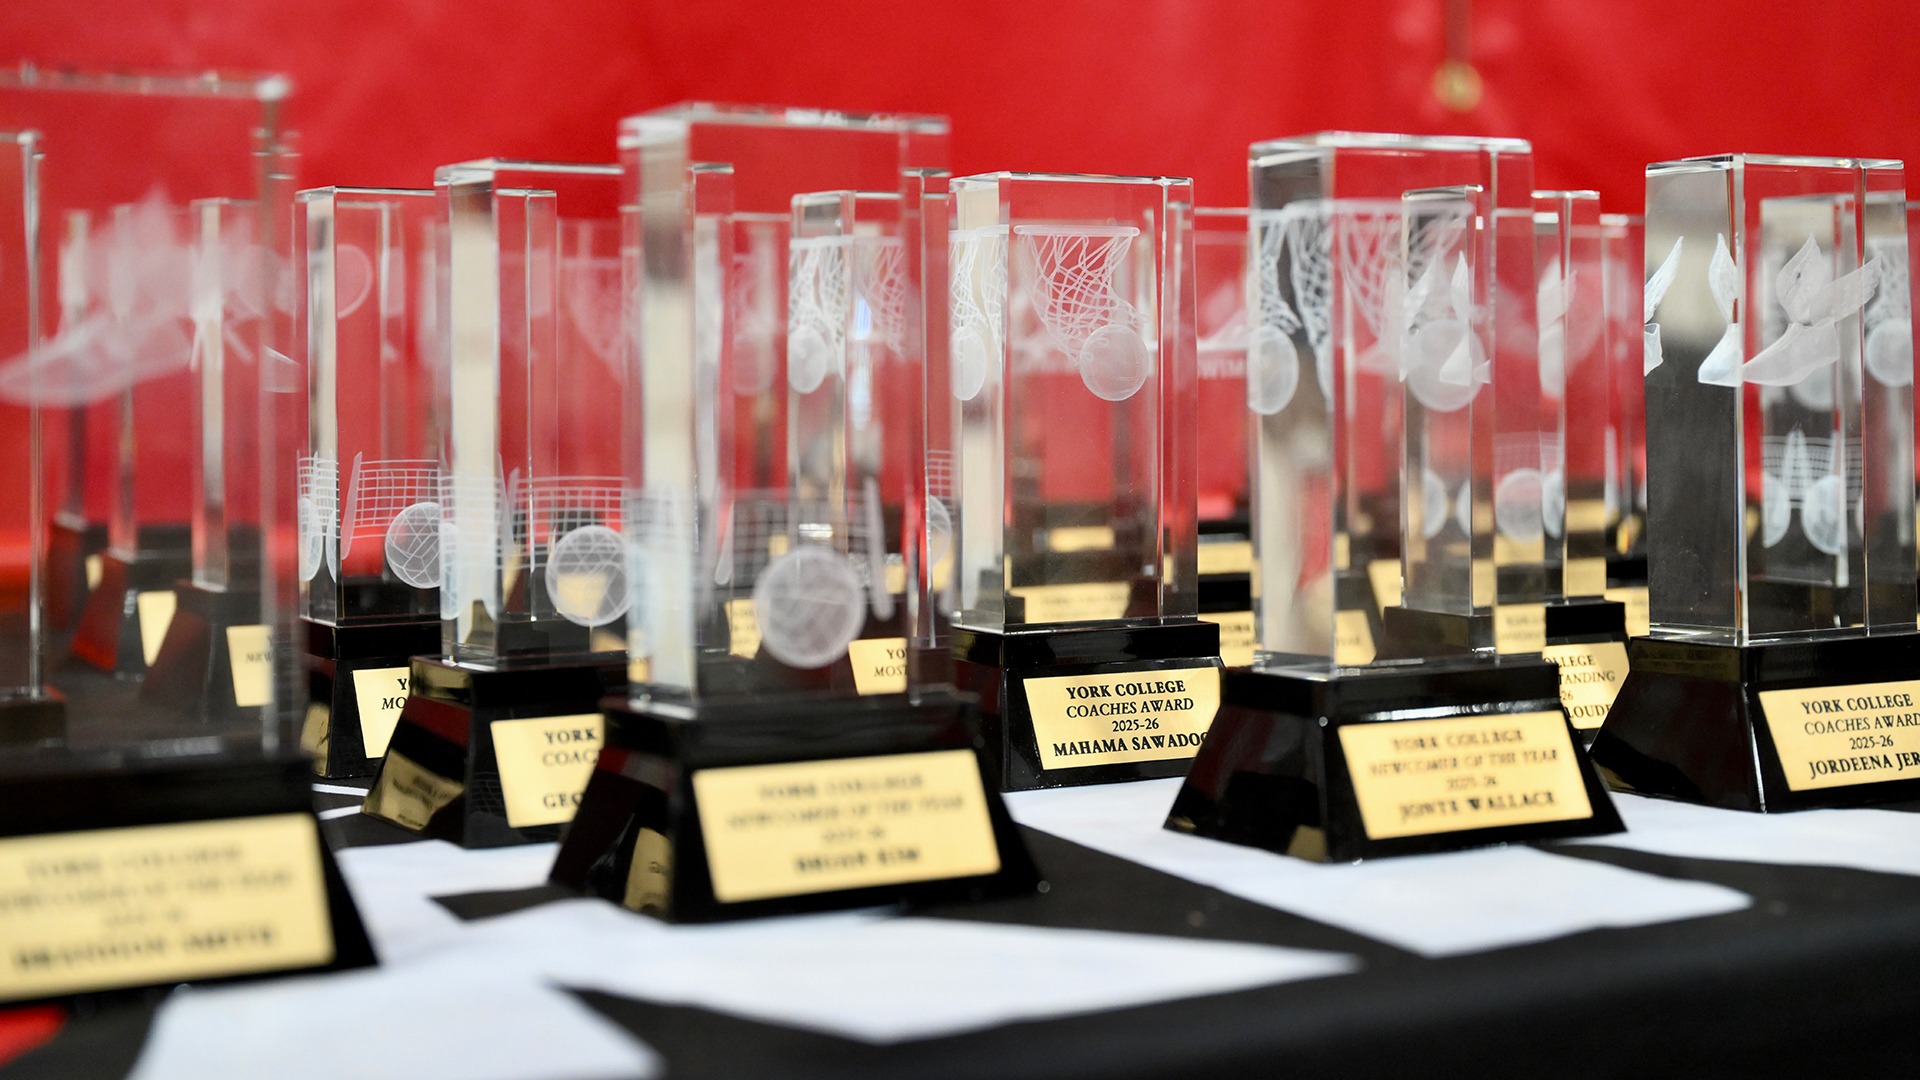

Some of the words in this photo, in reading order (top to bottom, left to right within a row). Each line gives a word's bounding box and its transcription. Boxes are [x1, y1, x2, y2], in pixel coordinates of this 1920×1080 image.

[1066, 685, 1112, 700] YORK
[1115, 680, 1186, 697] COLLEGE
[1066, 701, 1137, 719] COACHES
[1141, 697, 1194, 713] AWARD
[1801, 699, 1844, 715] YORK
[1846, 693, 1914, 712] COLLEGE
[1112, 717, 1160, 732] 2025-26
[1804, 716, 1871, 736] COACHES
[545, 728, 597, 744] YORK
[1849, 734, 1894, 751] 2025-26
[1053, 737, 1128, 757] MAHAMA
[1808, 753, 1893, 780] JORDEENA
